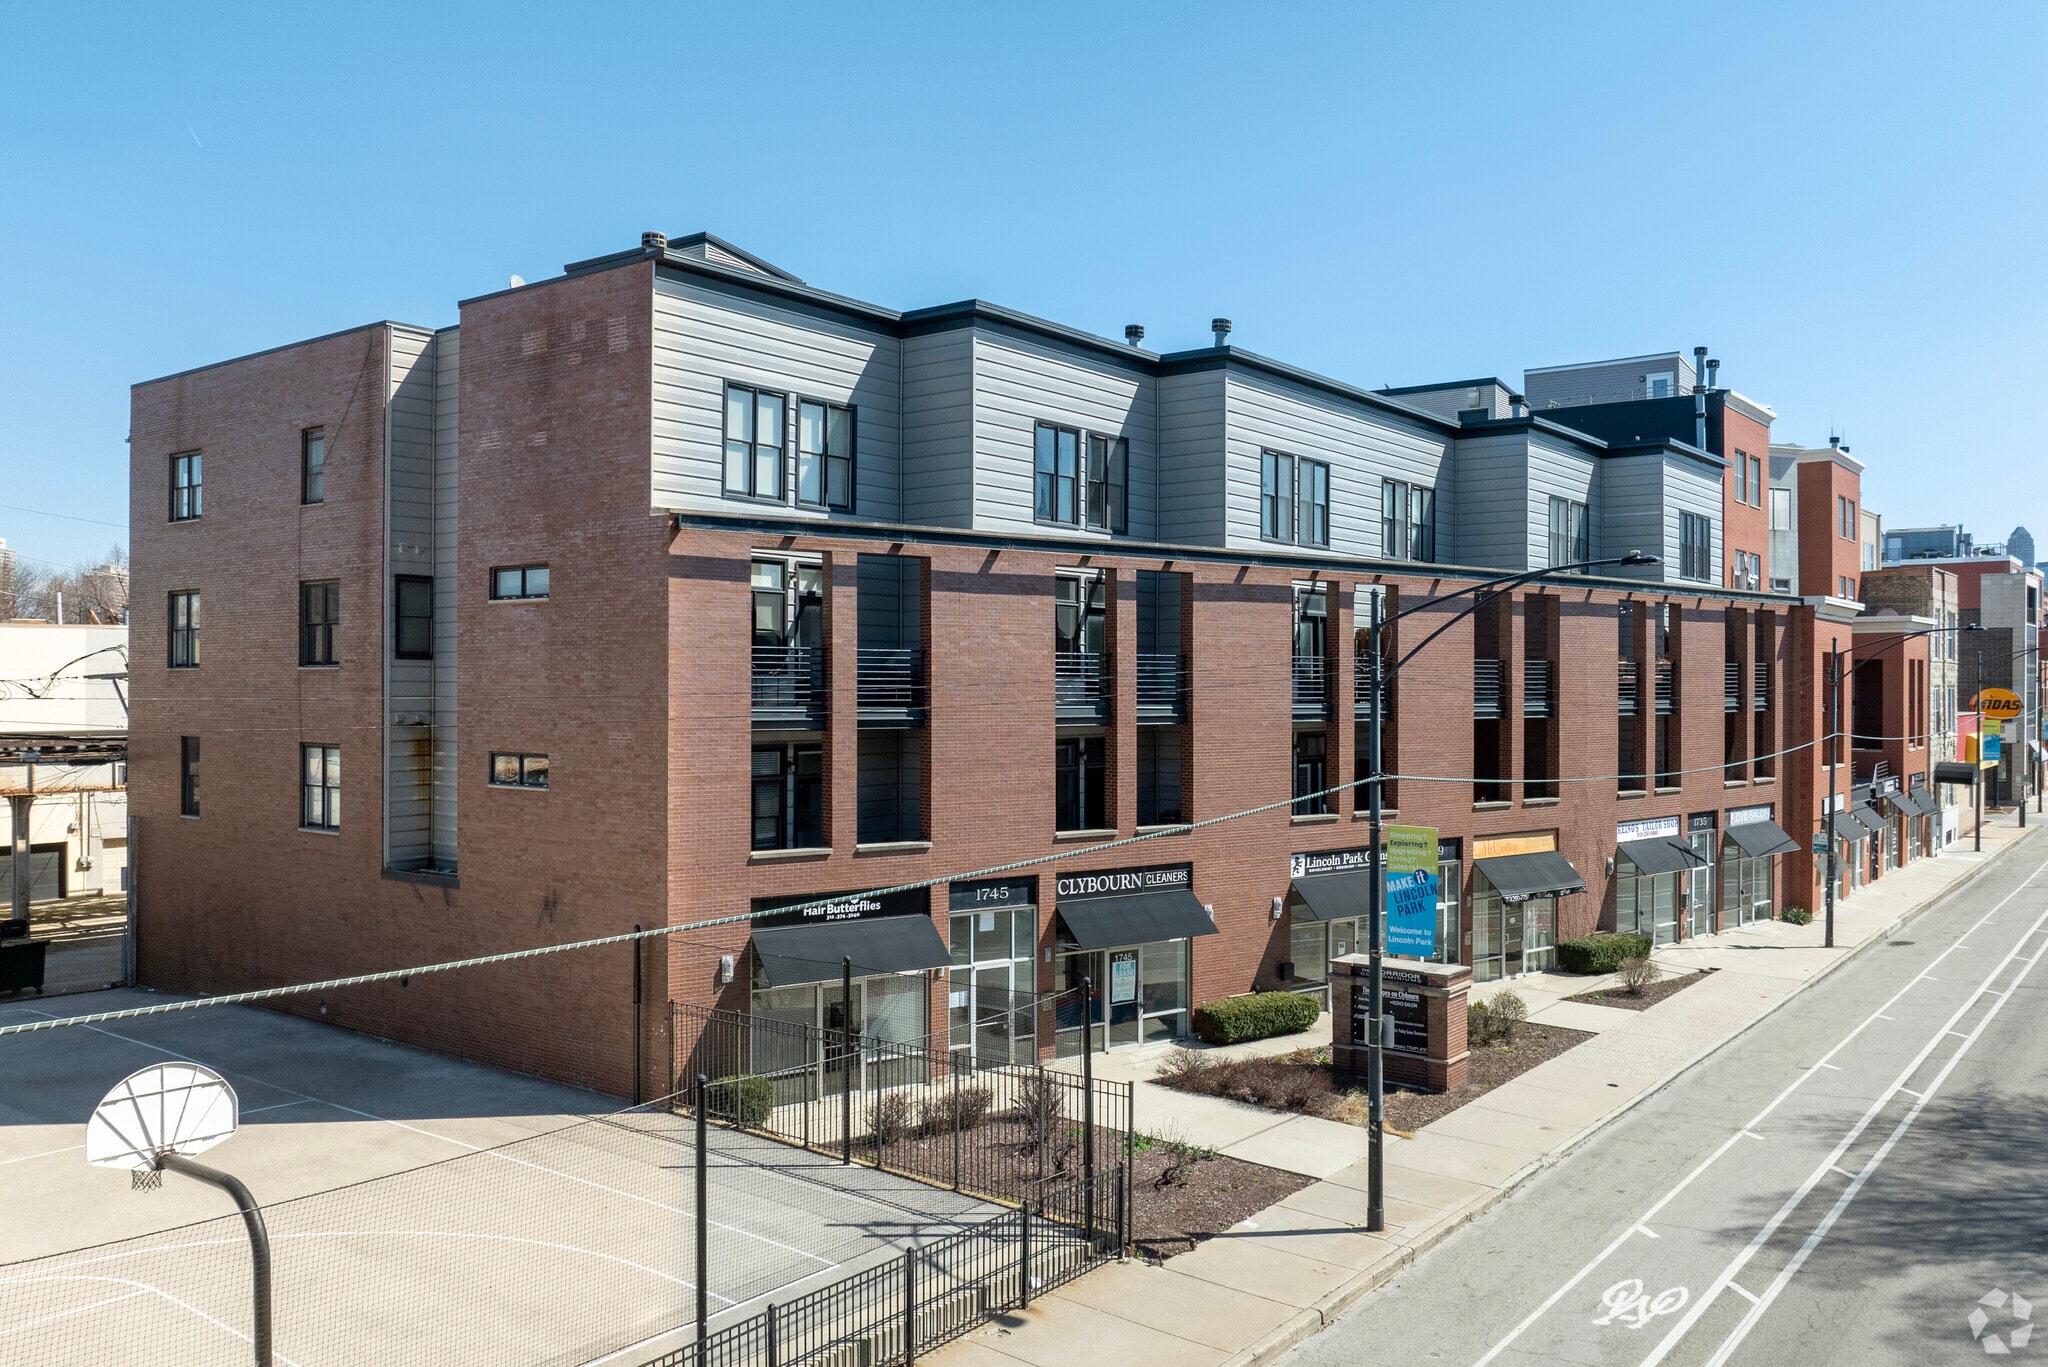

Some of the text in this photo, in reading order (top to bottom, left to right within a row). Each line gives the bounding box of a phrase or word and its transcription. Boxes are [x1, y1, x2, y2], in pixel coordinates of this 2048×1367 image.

[1749, 807, 1769, 818] SALON
[1642, 821, 1662, 832] TAILOR
[1663, 817, 1679, 829] SHOP
[1694, 817, 1707, 827] 1735
[1390, 832, 1427, 840] Shopping?
[1390, 840, 1428, 848] Exploring?
[1390, 848, 1431, 856] Upgrading?
[1306, 854, 1340, 868] Lincoln
[1343, 852, 1363, 864] Park
[1390, 855, 1416, 863] Living?
[1390, 863, 1436, 873] Celebrating?
[1058, 871, 1189, 896] CLYBOURN CLEANERS
[1386, 870, 1426, 893] MAKE it
[976, 886, 1009, 901] 1745
[1393, 883, 1438, 905] LINCOLN
[803, 900, 881, 916] Hair Butterflies
[1397, 900, 1426, 917] PARK
[1389, 926, 1422, 935] Welcome
[1388, 935, 1414, 944] Lincoln
[1114, 953, 1133, 962] 1745
[1398, 992, 1420, 1000] Clybourn
